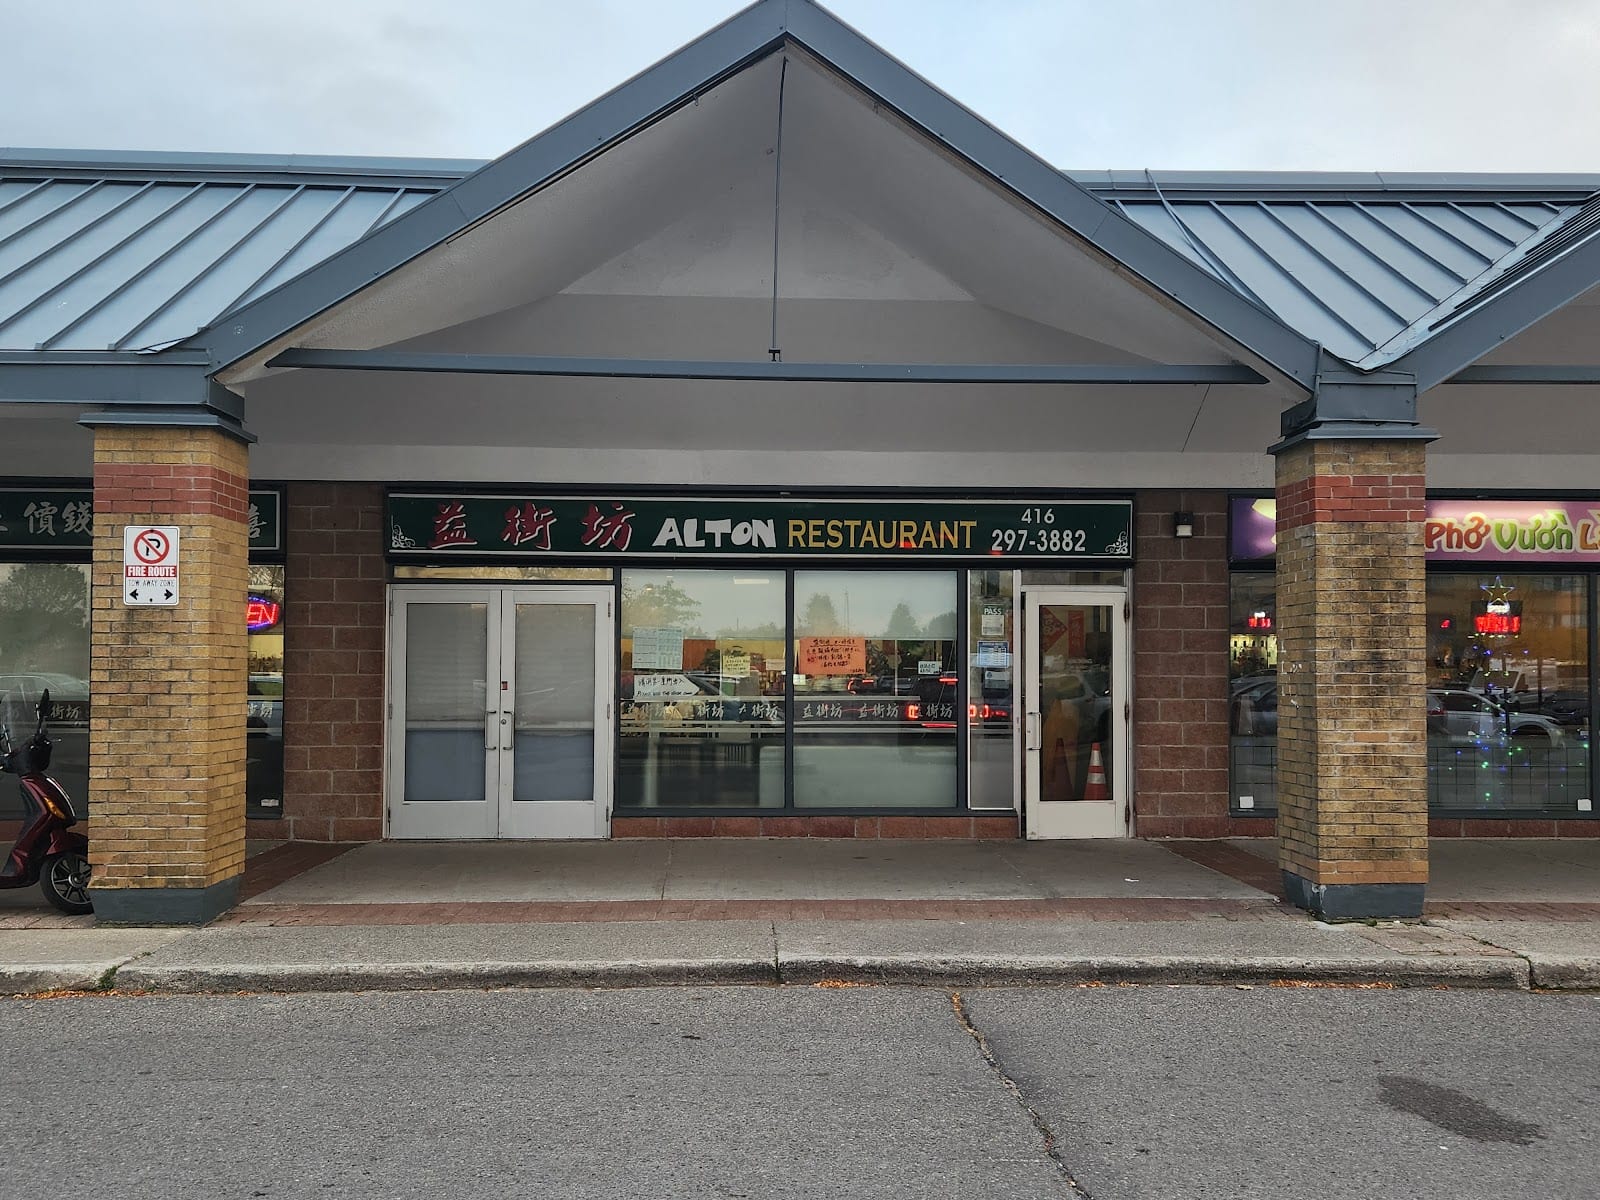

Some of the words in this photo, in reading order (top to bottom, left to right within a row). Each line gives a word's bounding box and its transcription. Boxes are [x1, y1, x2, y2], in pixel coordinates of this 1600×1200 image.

[0, 501, 93, 536] 價錢
[431, 502, 636, 551] 益街坊
[1021, 508, 1056, 525] 416
[652, 517, 777, 548] ALTON
[787, 519, 977, 549] RESTAURANT
[991, 529, 1086, 552] 297-3882
[127, 566, 148, 577] FIRE
[147, 566, 176, 577] ROUTE
[248, 603, 278, 624] EN
[50, 703, 80, 719] 街坊
